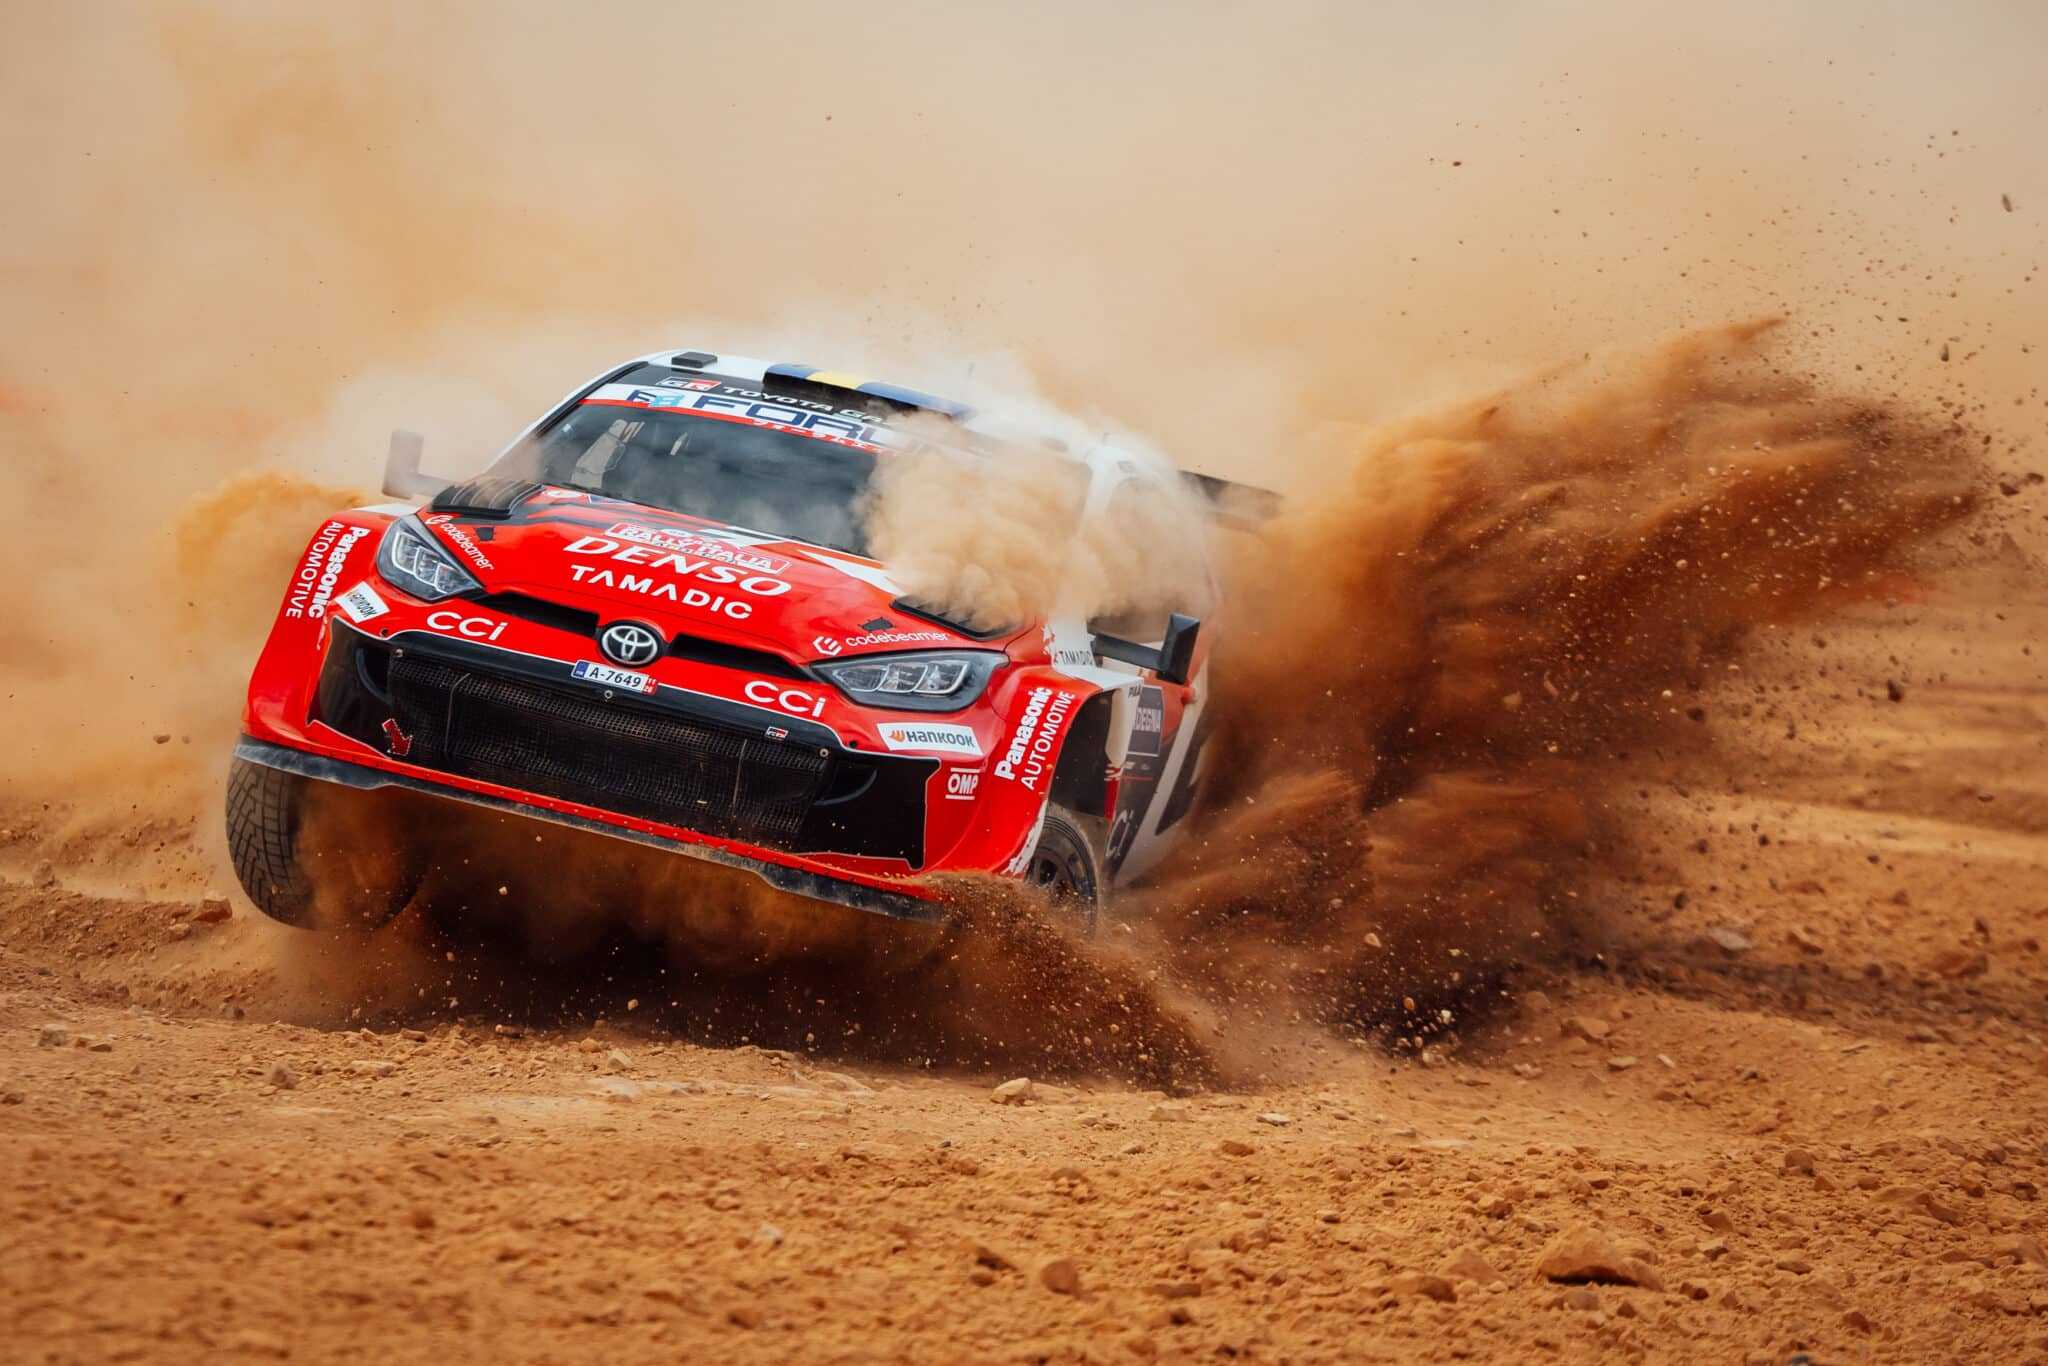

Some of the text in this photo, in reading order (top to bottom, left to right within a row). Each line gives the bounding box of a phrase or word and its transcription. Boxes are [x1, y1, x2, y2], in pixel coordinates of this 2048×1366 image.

[723, 387, 833, 411] TOYOTA
[286, 521, 344, 619] AUTOMOTIVE
[308, 526, 371, 618] Panasonic
[440, 522, 494, 571] codebeamer
[563, 536, 792, 596] DENSO
[617, 526, 694, 549] RALLY
[697, 542, 773, 570] ITALIA
[570, 565, 752, 619] TAMADIC
[845, 632, 949, 647] codebeamer
[589, 667, 642, 687] A-7649
[994, 687, 1053, 780] Panasonic
[1021, 690, 1076, 790] AUTOMOTIVE
[947, 774, 979, 794] OMP
